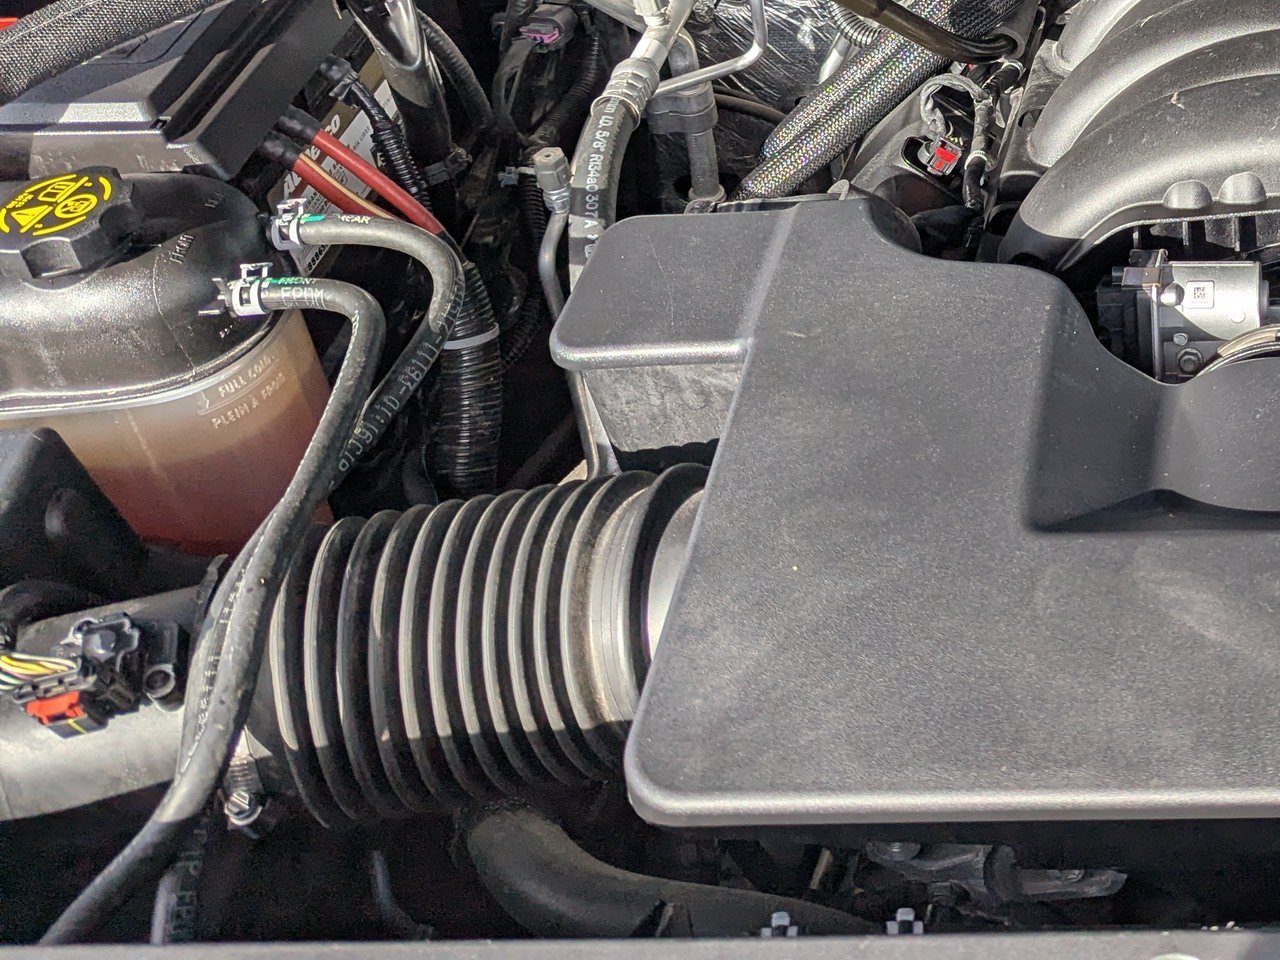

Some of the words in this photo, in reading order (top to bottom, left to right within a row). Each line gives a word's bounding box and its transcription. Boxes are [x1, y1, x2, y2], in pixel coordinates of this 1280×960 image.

[281, 286, 327, 309] EPDM
[218, 375, 247, 398] FULL
[211, 402, 250, 429] PLEIN
